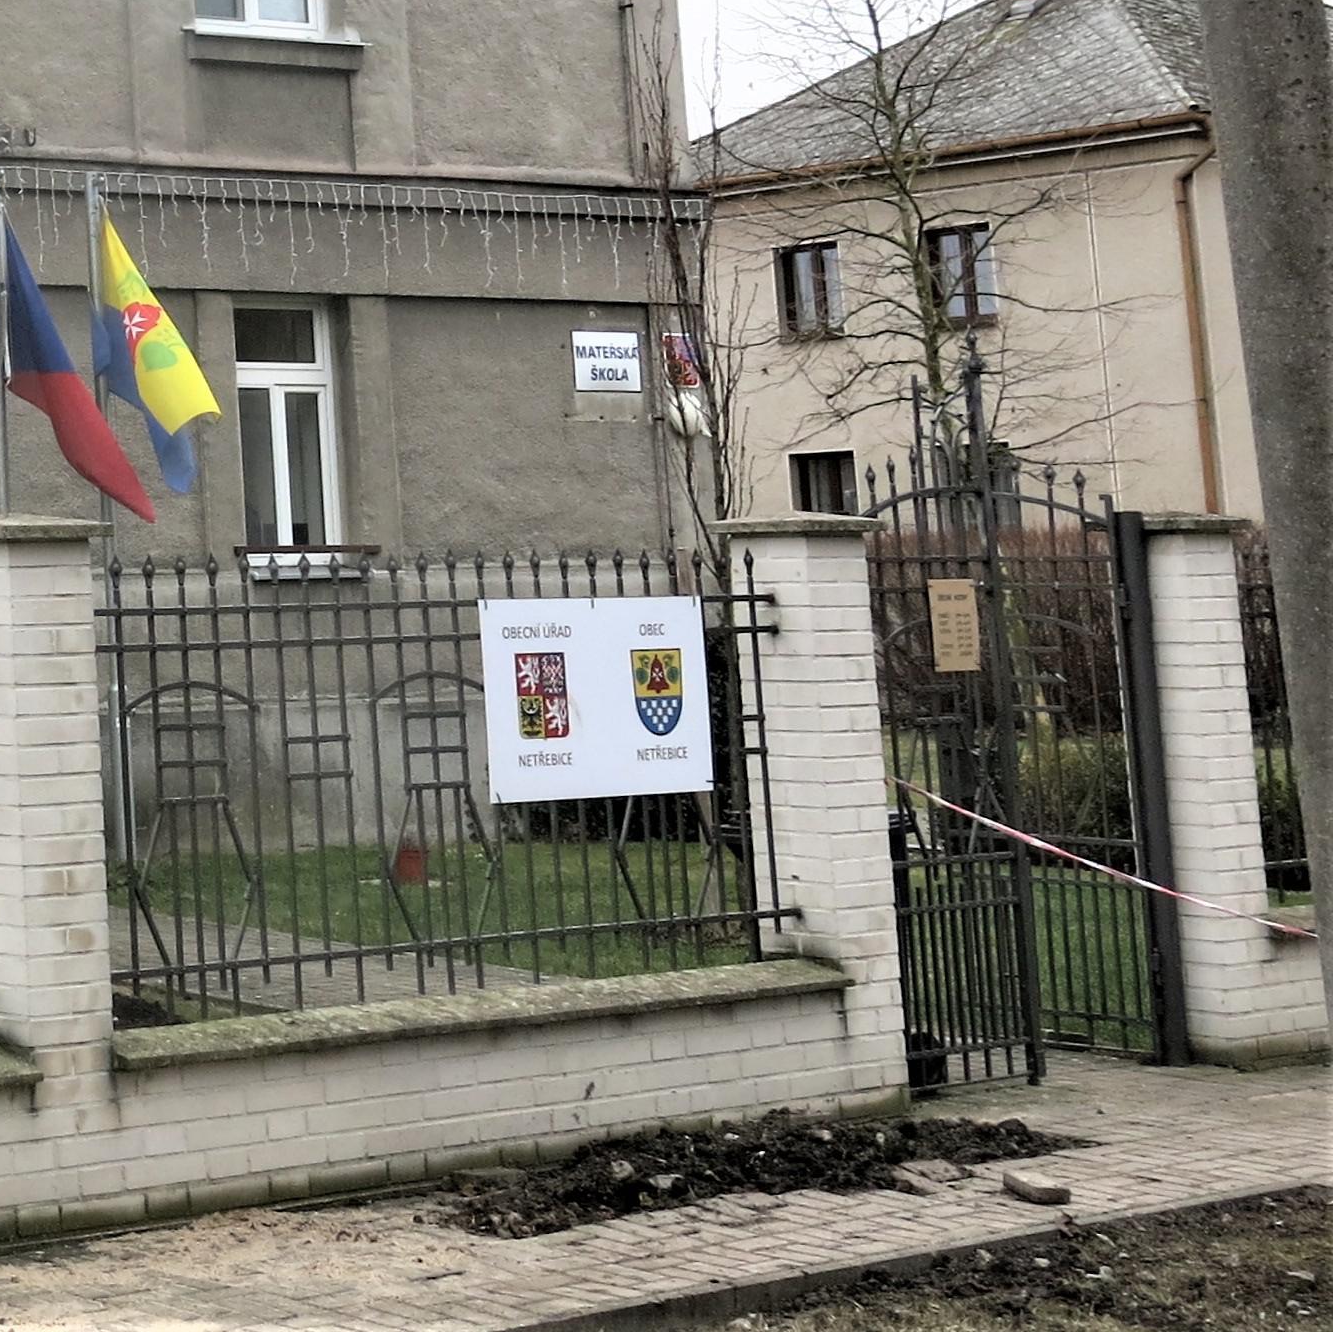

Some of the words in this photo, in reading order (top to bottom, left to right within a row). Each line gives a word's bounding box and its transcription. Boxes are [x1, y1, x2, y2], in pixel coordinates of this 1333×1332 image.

[590, 365, 629, 381] ŠKOLA
[502, 623, 540, 639] OBECNÍ
[543, 622, 572, 638] ÚŘAD
[638, 623, 665, 636] OBEC
[518, 751, 573, 767] NETŘEBICE
[636, 746, 688, 761] NETŘEBICE
